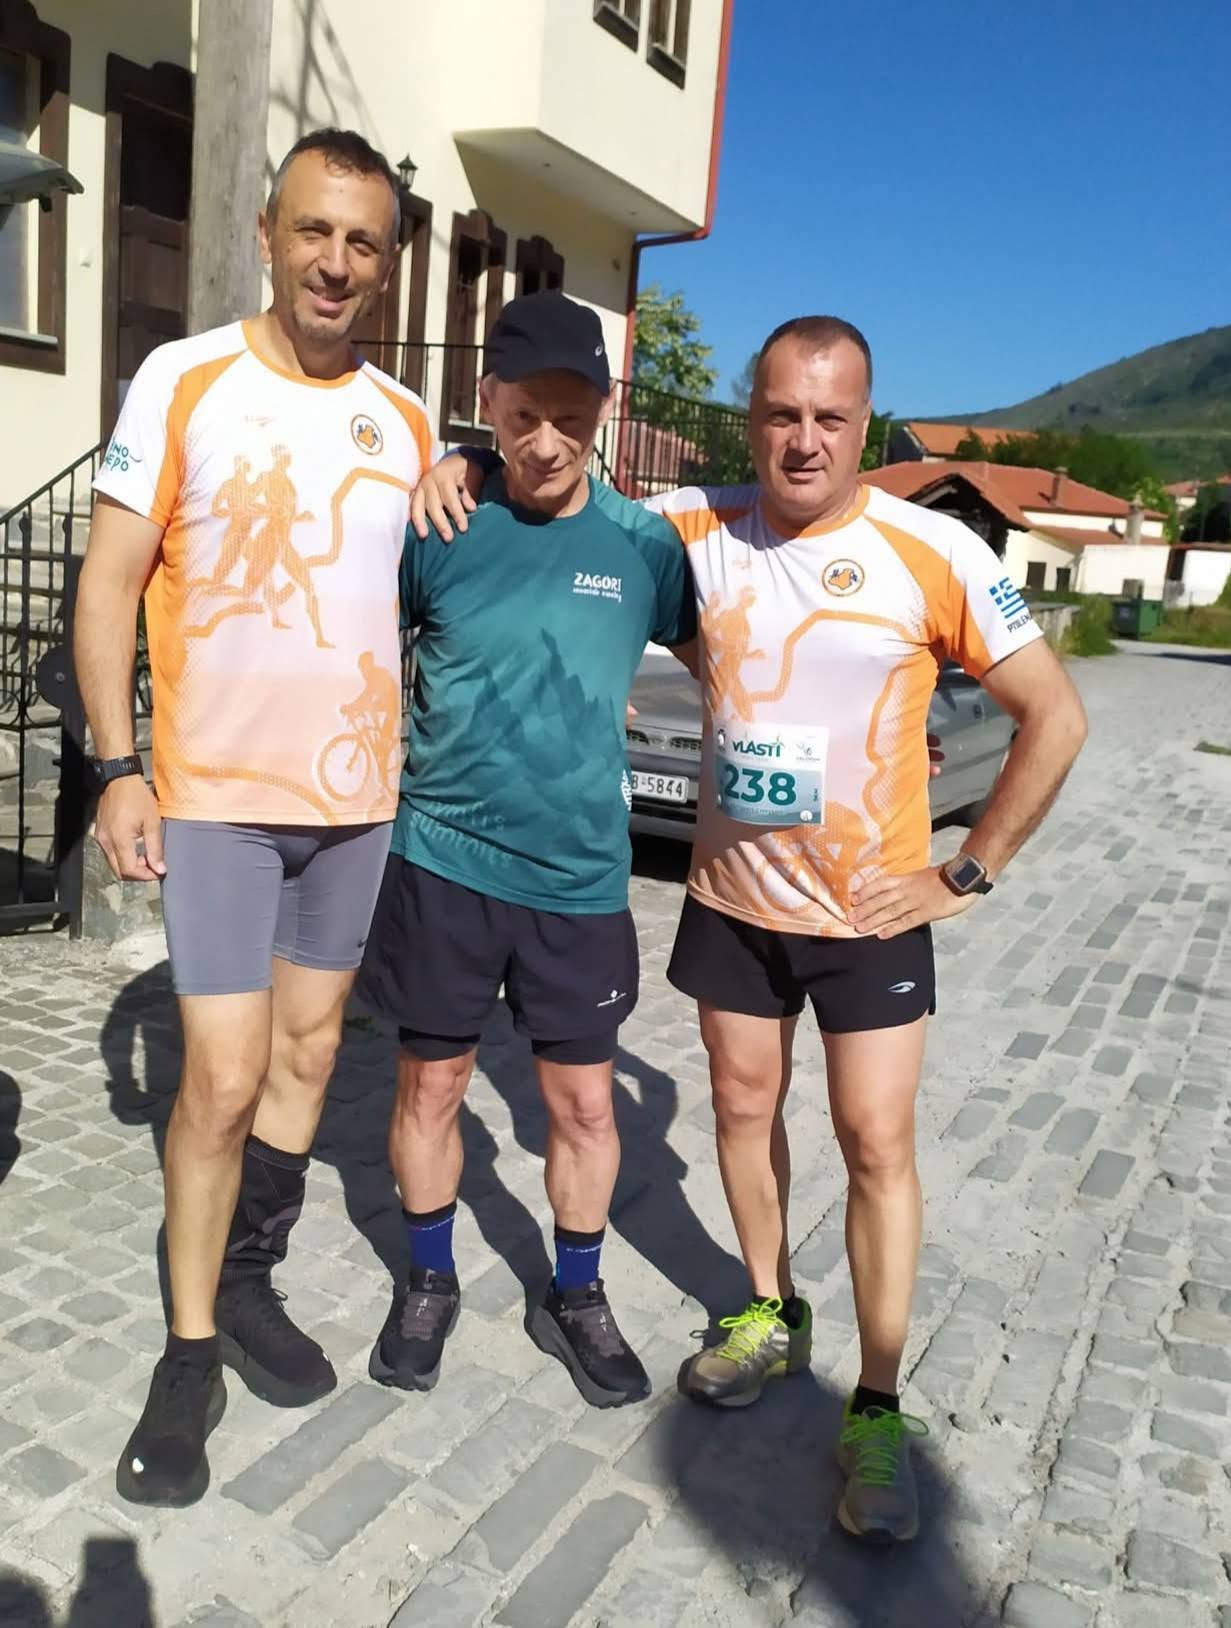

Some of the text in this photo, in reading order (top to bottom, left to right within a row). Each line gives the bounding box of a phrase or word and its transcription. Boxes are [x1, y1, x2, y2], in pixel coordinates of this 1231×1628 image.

[574, 571, 622, 592] ZAGORI
[732, 740, 781, 757] VLASTI
[723, 763, 797, 806] 238
